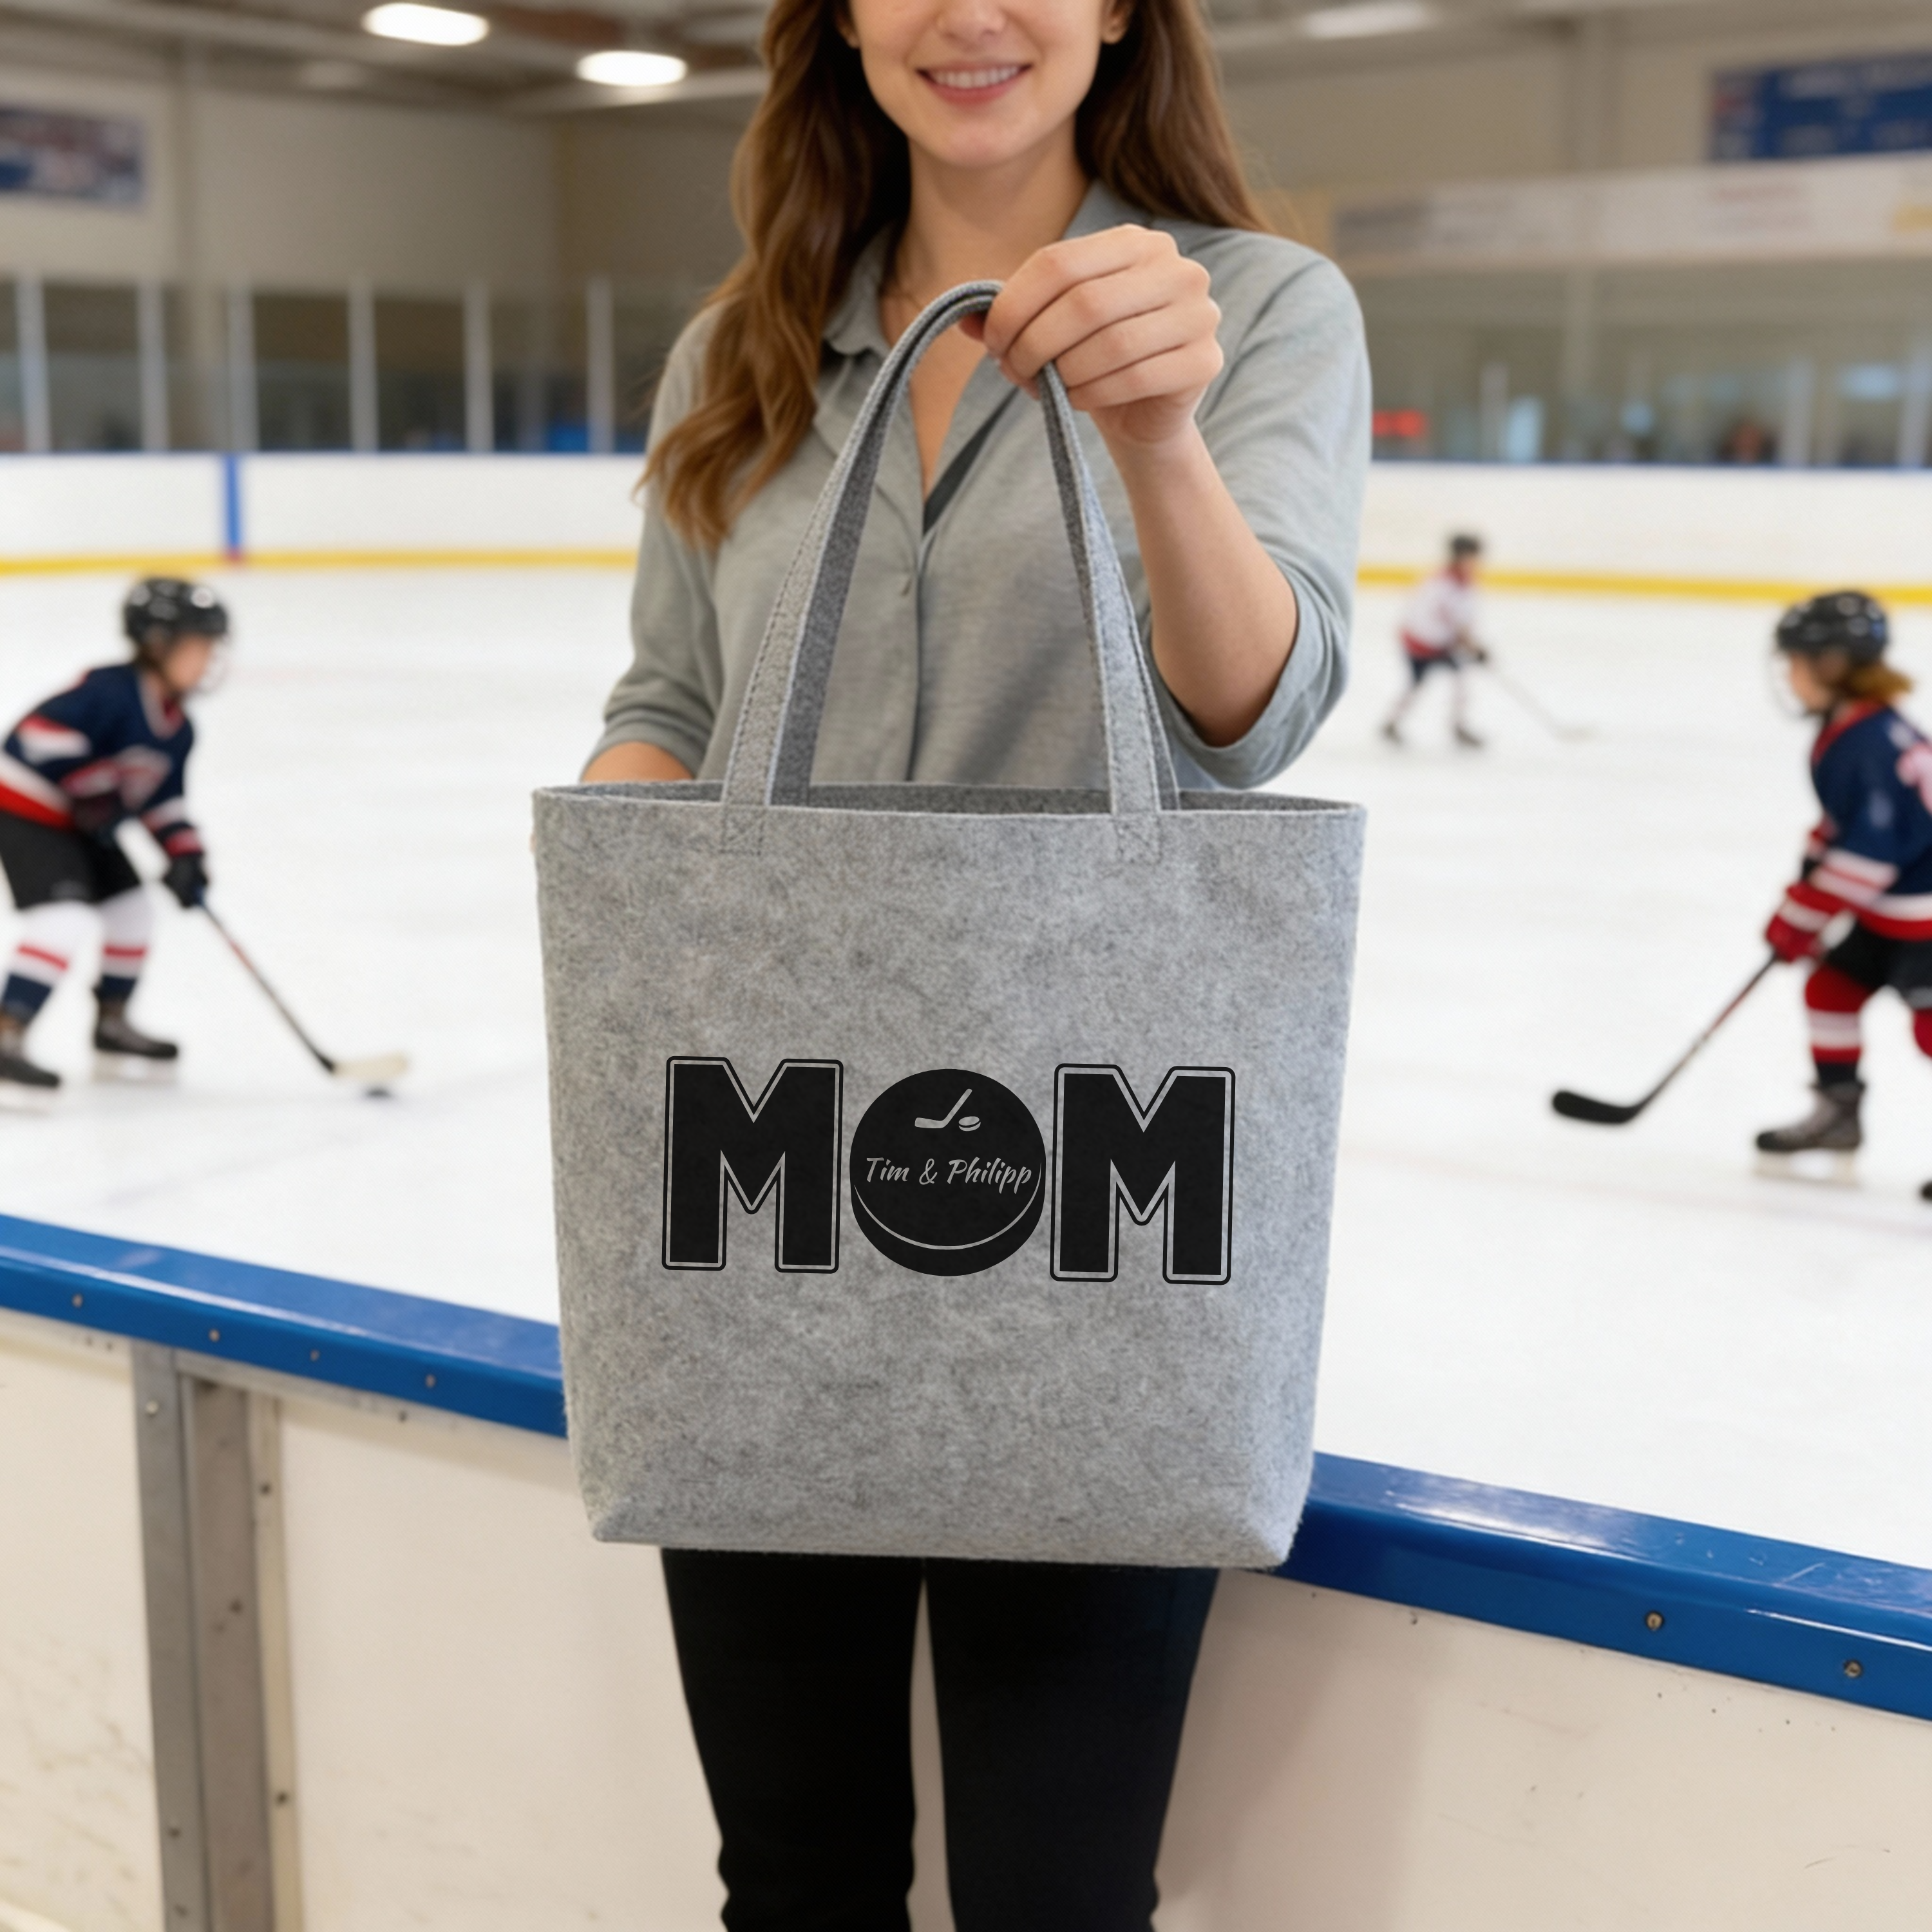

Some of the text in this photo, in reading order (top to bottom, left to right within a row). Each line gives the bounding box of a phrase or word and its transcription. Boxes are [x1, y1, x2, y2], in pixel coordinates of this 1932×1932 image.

[662, 1056, 1235, 1285] MOM
[866, 1157, 1032, 1194] Tim & Philipp
